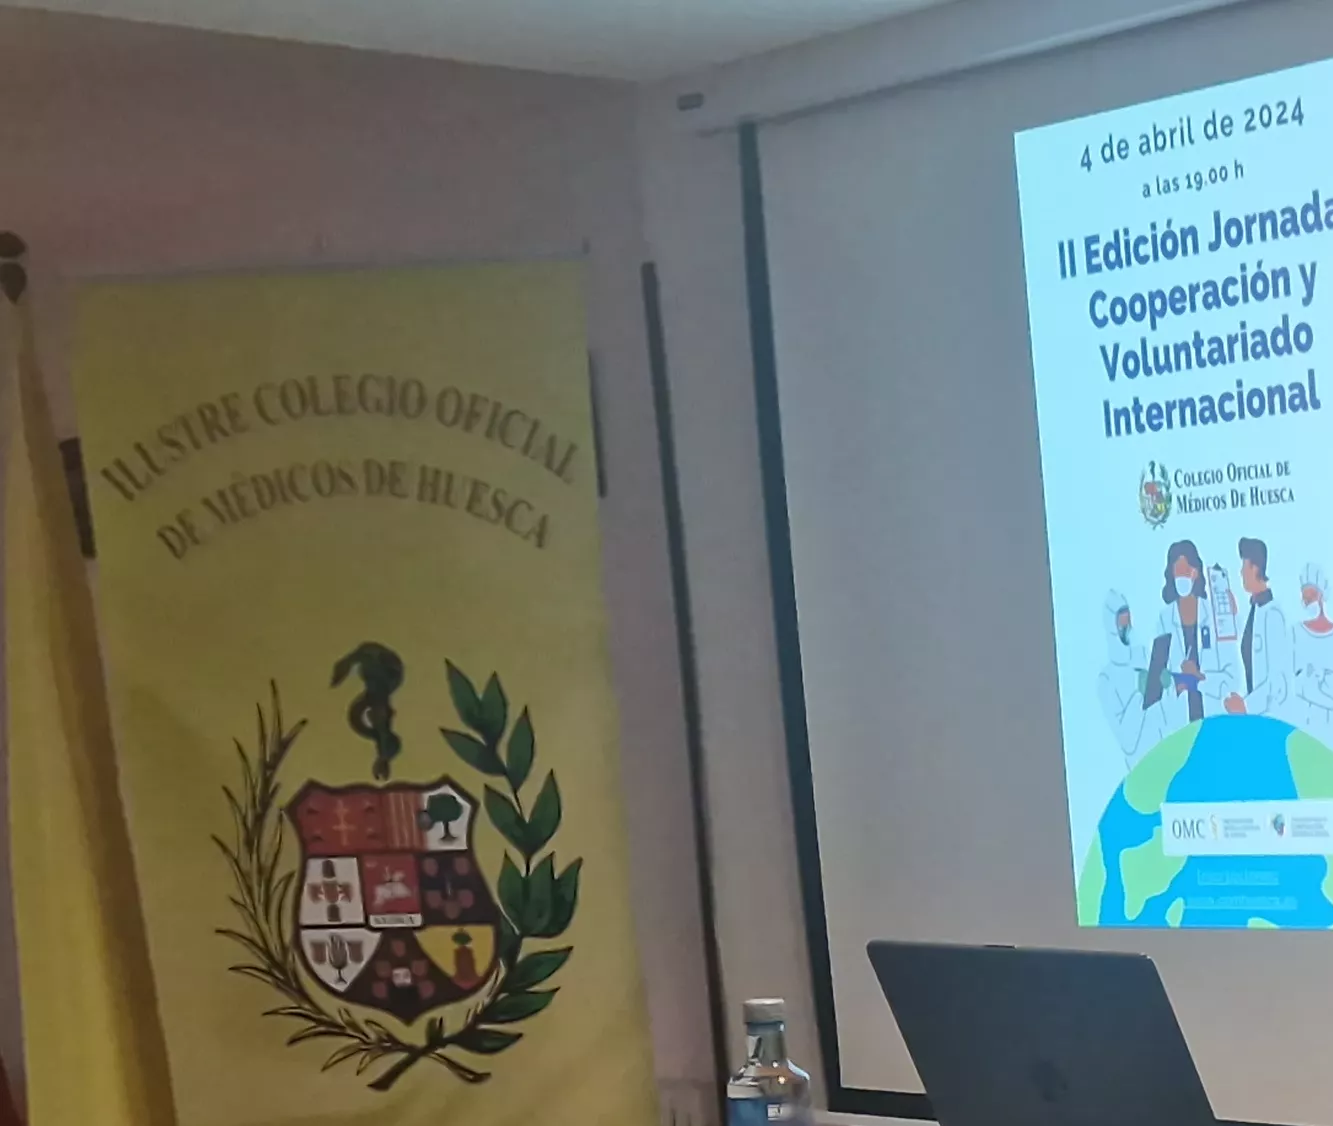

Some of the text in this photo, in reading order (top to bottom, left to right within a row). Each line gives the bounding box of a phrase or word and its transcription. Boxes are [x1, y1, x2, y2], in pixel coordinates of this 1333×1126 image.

[1079, 97, 1305, 172] 4 de abril de 2024
[1142, 160, 1244, 198] a las 19.00 h
[1057, 239, 1077, 279] II
[1084, 218, 1199, 275] Edición
[1088, 260, 1317, 331] Cooperación y
[1100, 314, 1314, 382] Voluntariado
[101, 373, 578, 501] ILUSTRE COLEGIO OFICIAL
[1103, 368, 1321, 438] Internacional
[1174, 460, 1291, 488] COLEGIO OFICIAL DE
[1176, 492, 1227, 514] MÉDICOS
[1250, 486, 1295, 507] HUESCA
[156, 508, 202, 560] DE
[363, 458, 410, 499] DE
[417, 463, 550, 550] HUESCA
[1172, 818, 1206, 839] OMC
